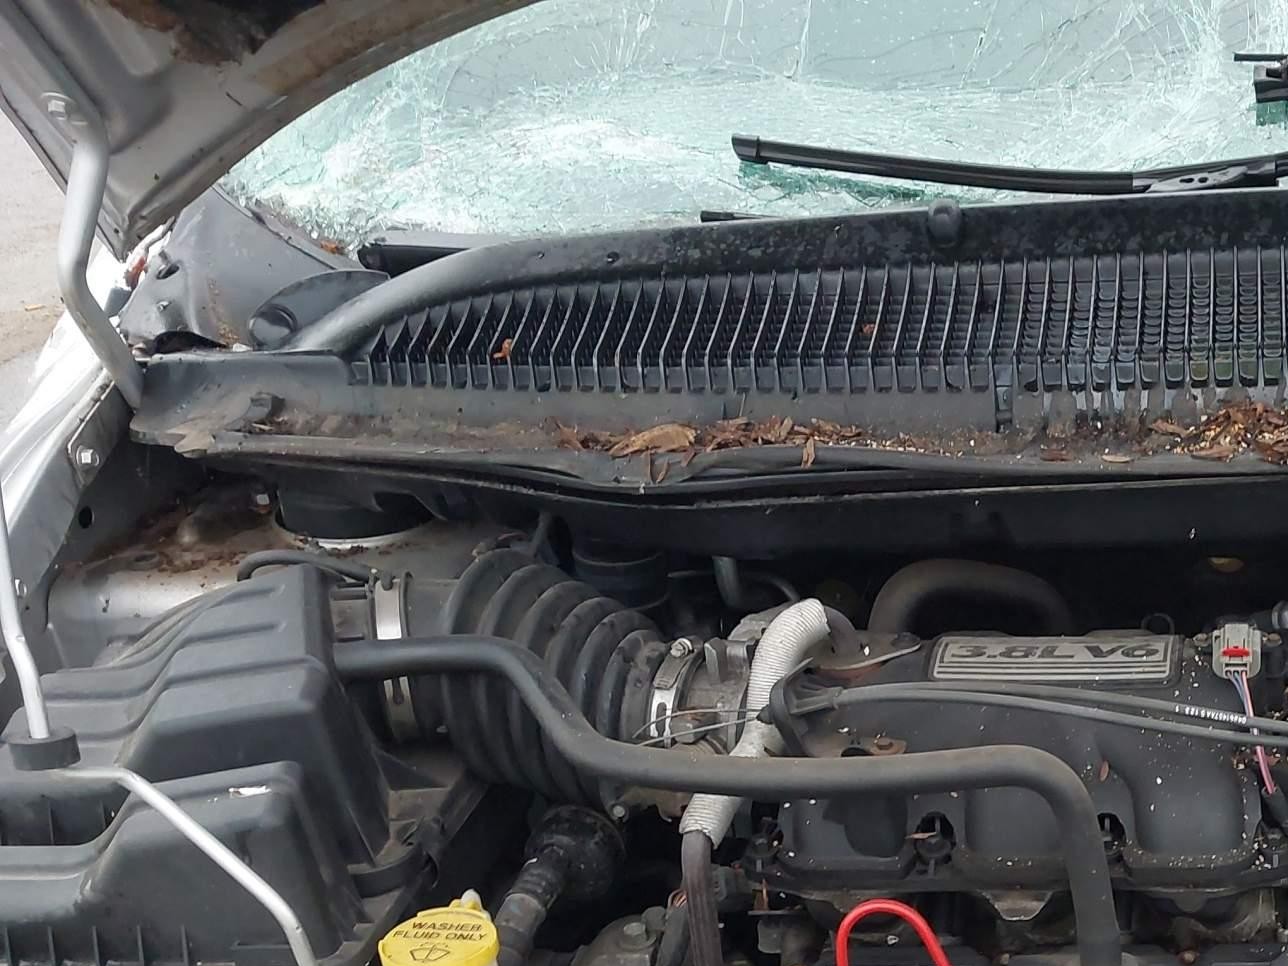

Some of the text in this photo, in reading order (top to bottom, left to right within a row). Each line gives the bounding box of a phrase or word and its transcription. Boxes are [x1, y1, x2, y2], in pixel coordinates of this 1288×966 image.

[951, 644, 1160, 659] 3.8L V6
[411, 922, 482, 932] WASHER
[392, 930, 488, 941] FLUID ONLY
